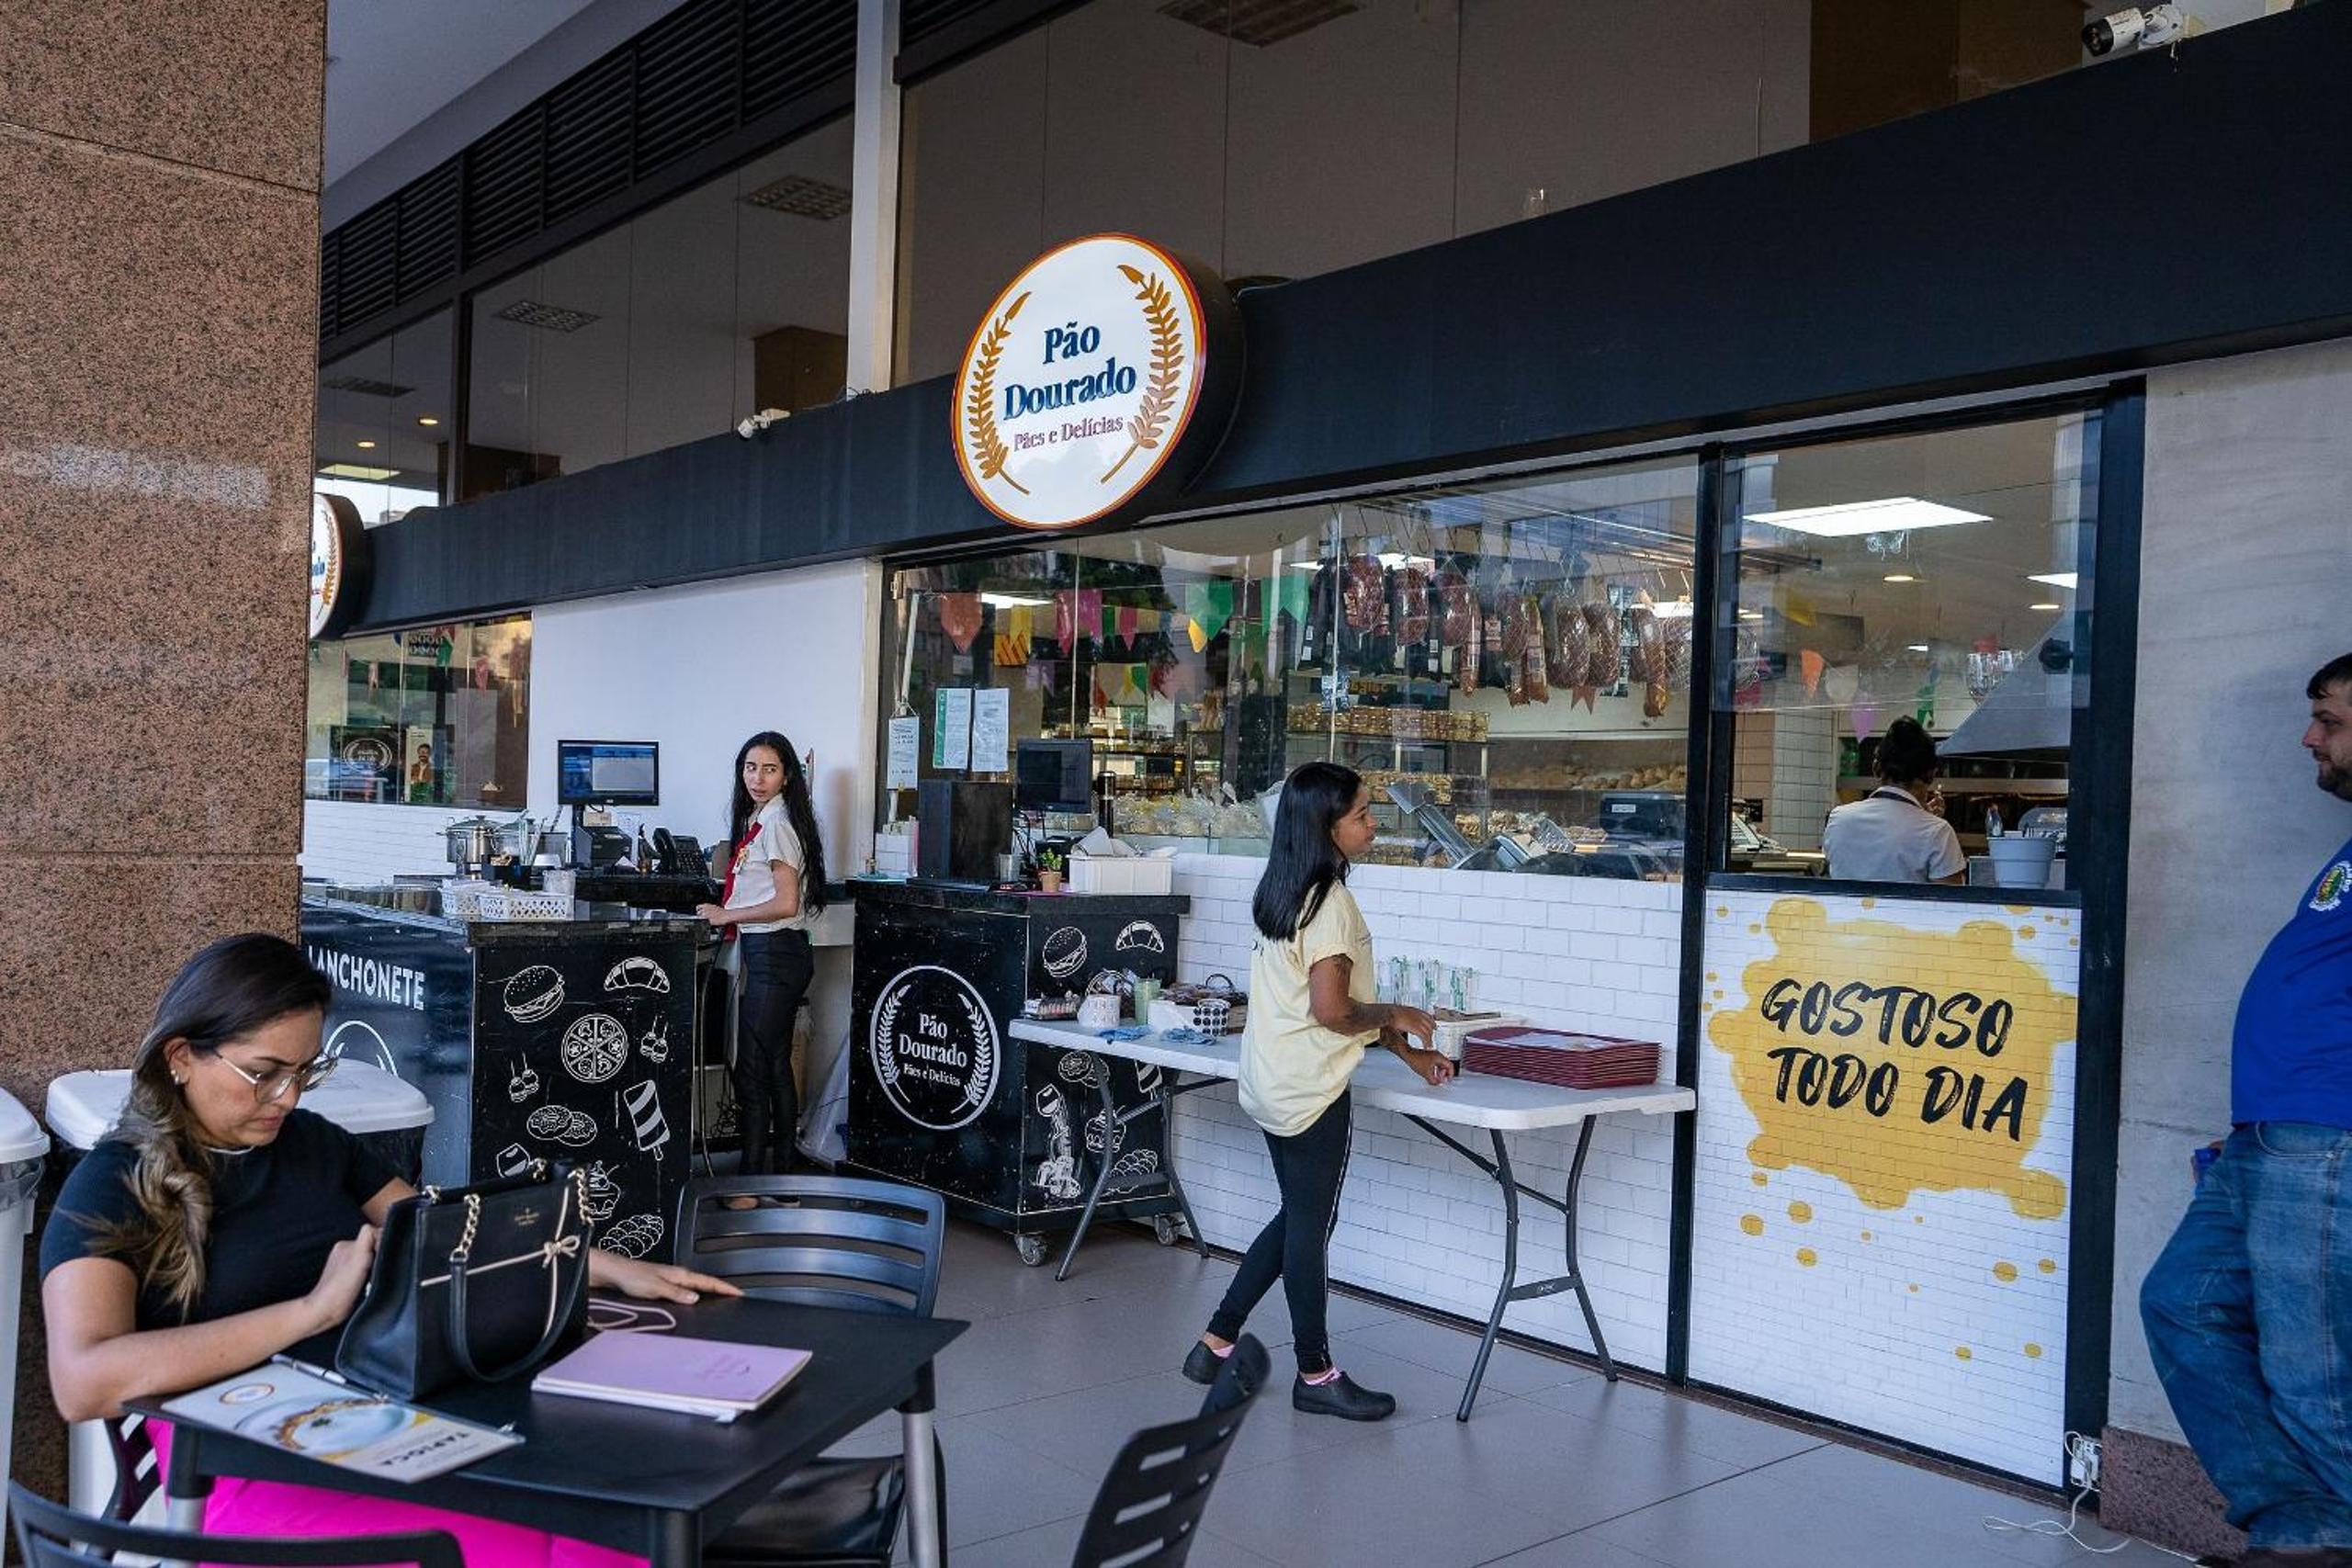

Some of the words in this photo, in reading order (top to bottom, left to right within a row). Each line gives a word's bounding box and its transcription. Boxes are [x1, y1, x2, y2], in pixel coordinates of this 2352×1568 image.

[1043, 321, 1101, 365] Pão
[1003, 357, 1137, 421] Dourado
[1014, 429, 1045, 451] Pães
[1048, 428, 1057, 445] e
[1061, 415, 1124, 443] Delícias
[919, 1012, 947, 1039] Pão
[1761, 978, 2014, 1057] GOSTOSO
[899, 1033, 967, 1067] Dourado
[1767, 1046, 1899, 1117] TODO
[1920, 1065, 2029, 1142] DIA
